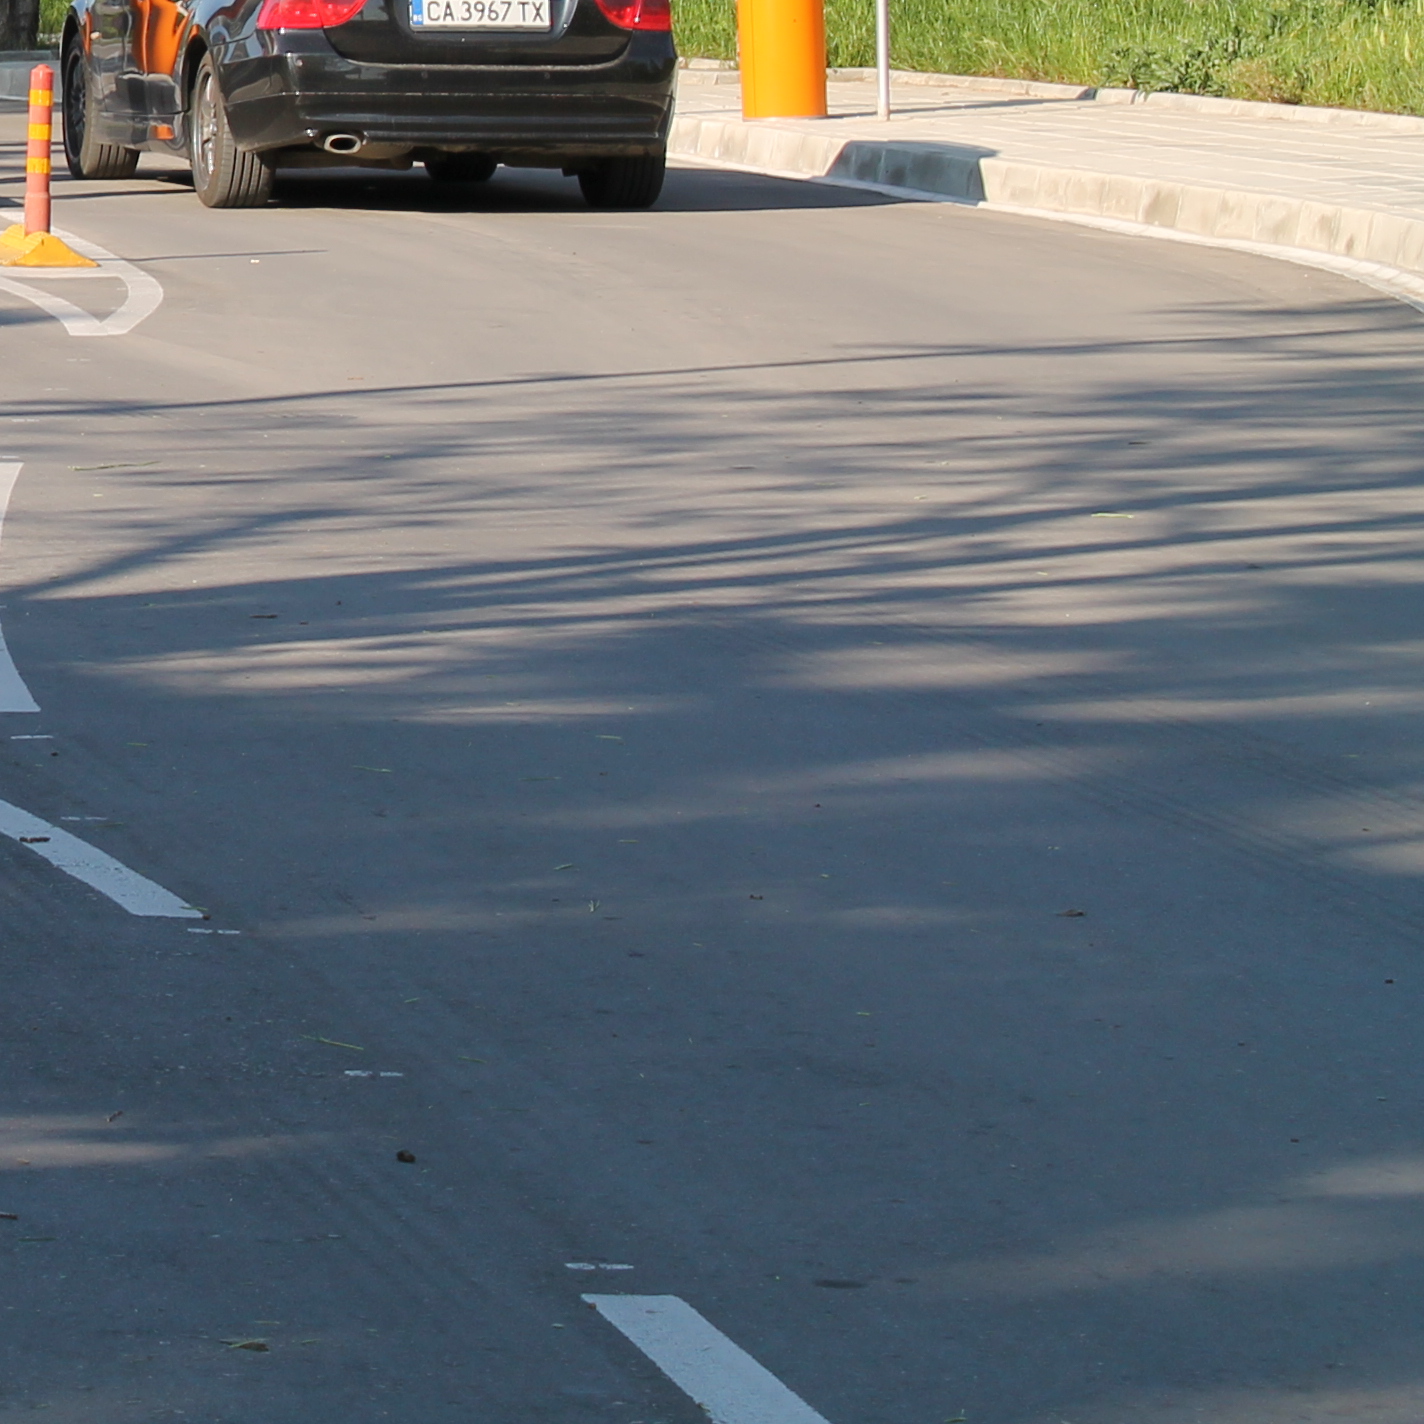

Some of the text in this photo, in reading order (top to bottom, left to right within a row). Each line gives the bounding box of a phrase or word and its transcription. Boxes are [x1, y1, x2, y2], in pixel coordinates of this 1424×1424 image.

[427, 0, 455, 22] CA
[460, 0, 512, 22] 3967
[517, 1, 545, 23] TX
